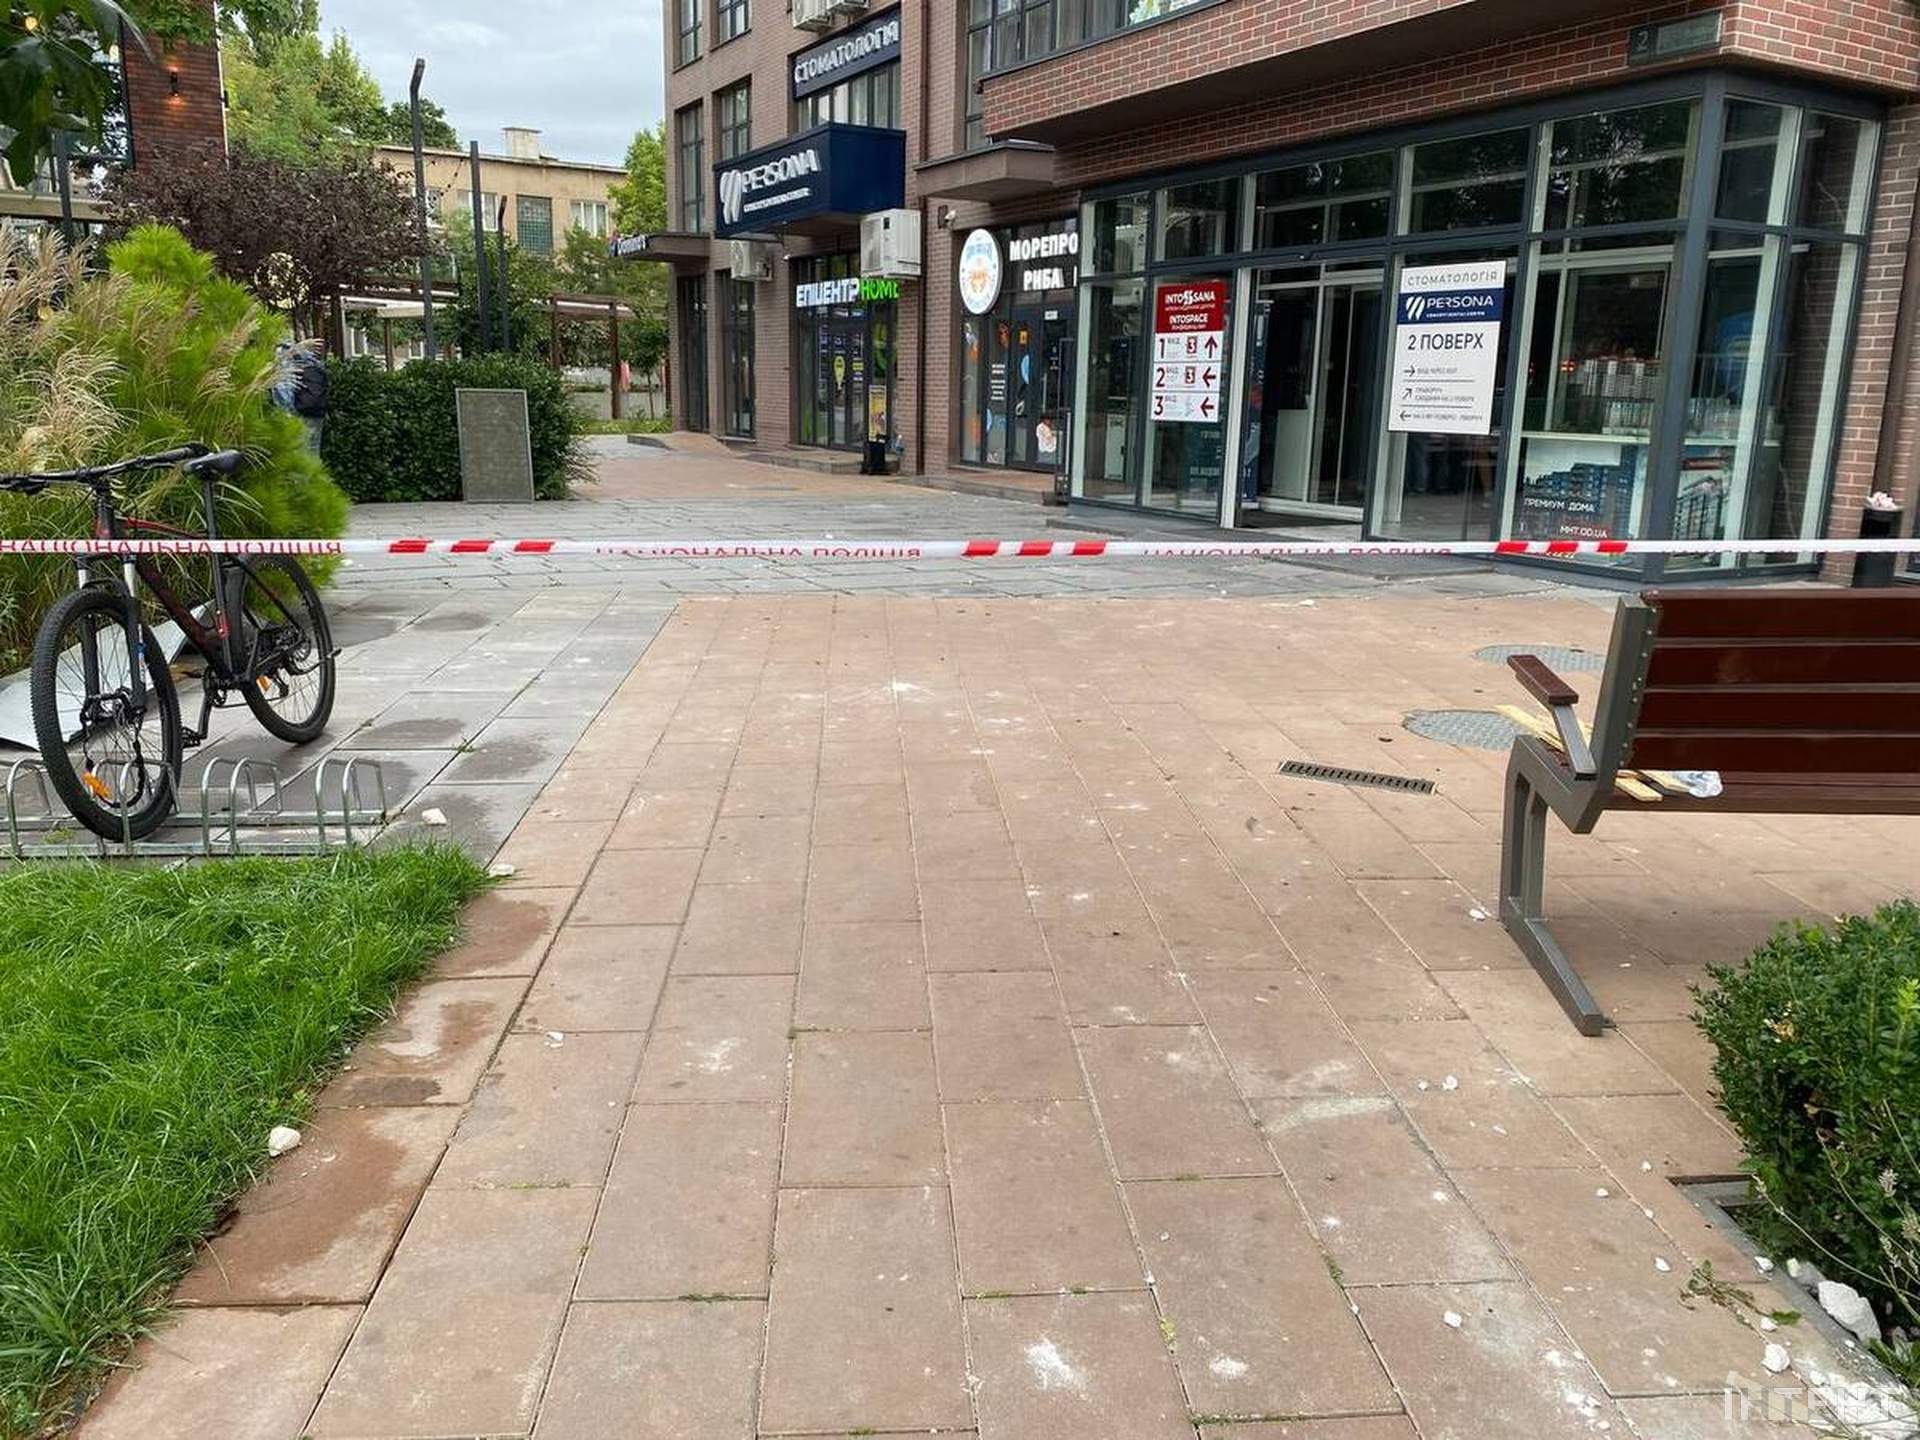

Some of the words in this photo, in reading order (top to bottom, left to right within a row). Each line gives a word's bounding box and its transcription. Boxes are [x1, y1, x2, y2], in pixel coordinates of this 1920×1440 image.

[741, 148, 821, 193] PERSONA
[1023, 267, 1064, 292] РИБА
[1426, 295, 1494, 309] PERSONA
[1169, 313, 1208, 324] INTOSPACE
[1158, 338, 1165, 359] 1
[1407, 334, 1417, 351] 2
[1420, 332, 1484, 351] ПОВЕРХ
[1155, 367, 1166, 388] 2
[1153, 395, 1164, 416] 3
